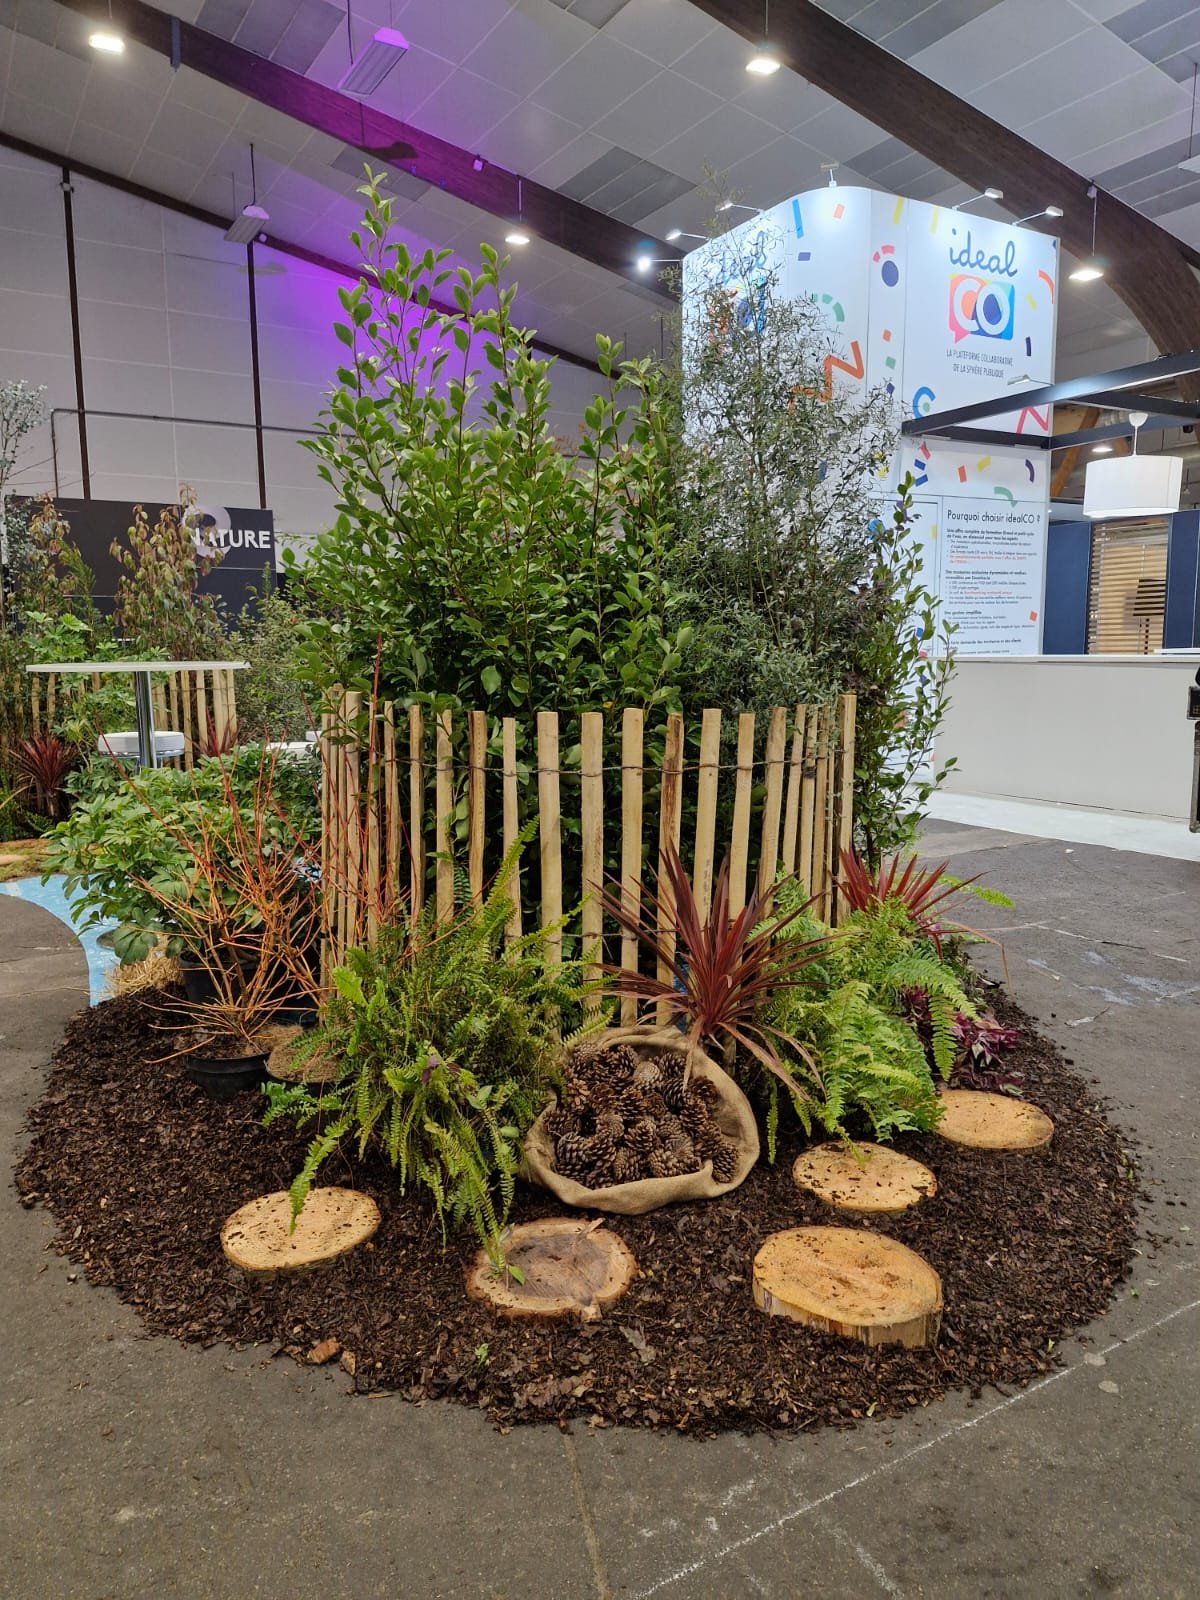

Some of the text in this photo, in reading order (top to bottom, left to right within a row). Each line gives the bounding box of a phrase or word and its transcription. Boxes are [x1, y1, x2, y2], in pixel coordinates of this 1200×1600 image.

[949, 228, 1018, 277] ideal
[952, 278, 1011, 336] CO
[946, 348, 1013, 367] LA PLATEFORME COLLABORATIVE
[953, 364, 1004, 378] DE LA SPHÈRE PUBLIQUE
[947, 509, 980, 523] Pourquoi
[981, 511, 1005, 522] choisir
[1006, 512, 1035, 524] idealCO
